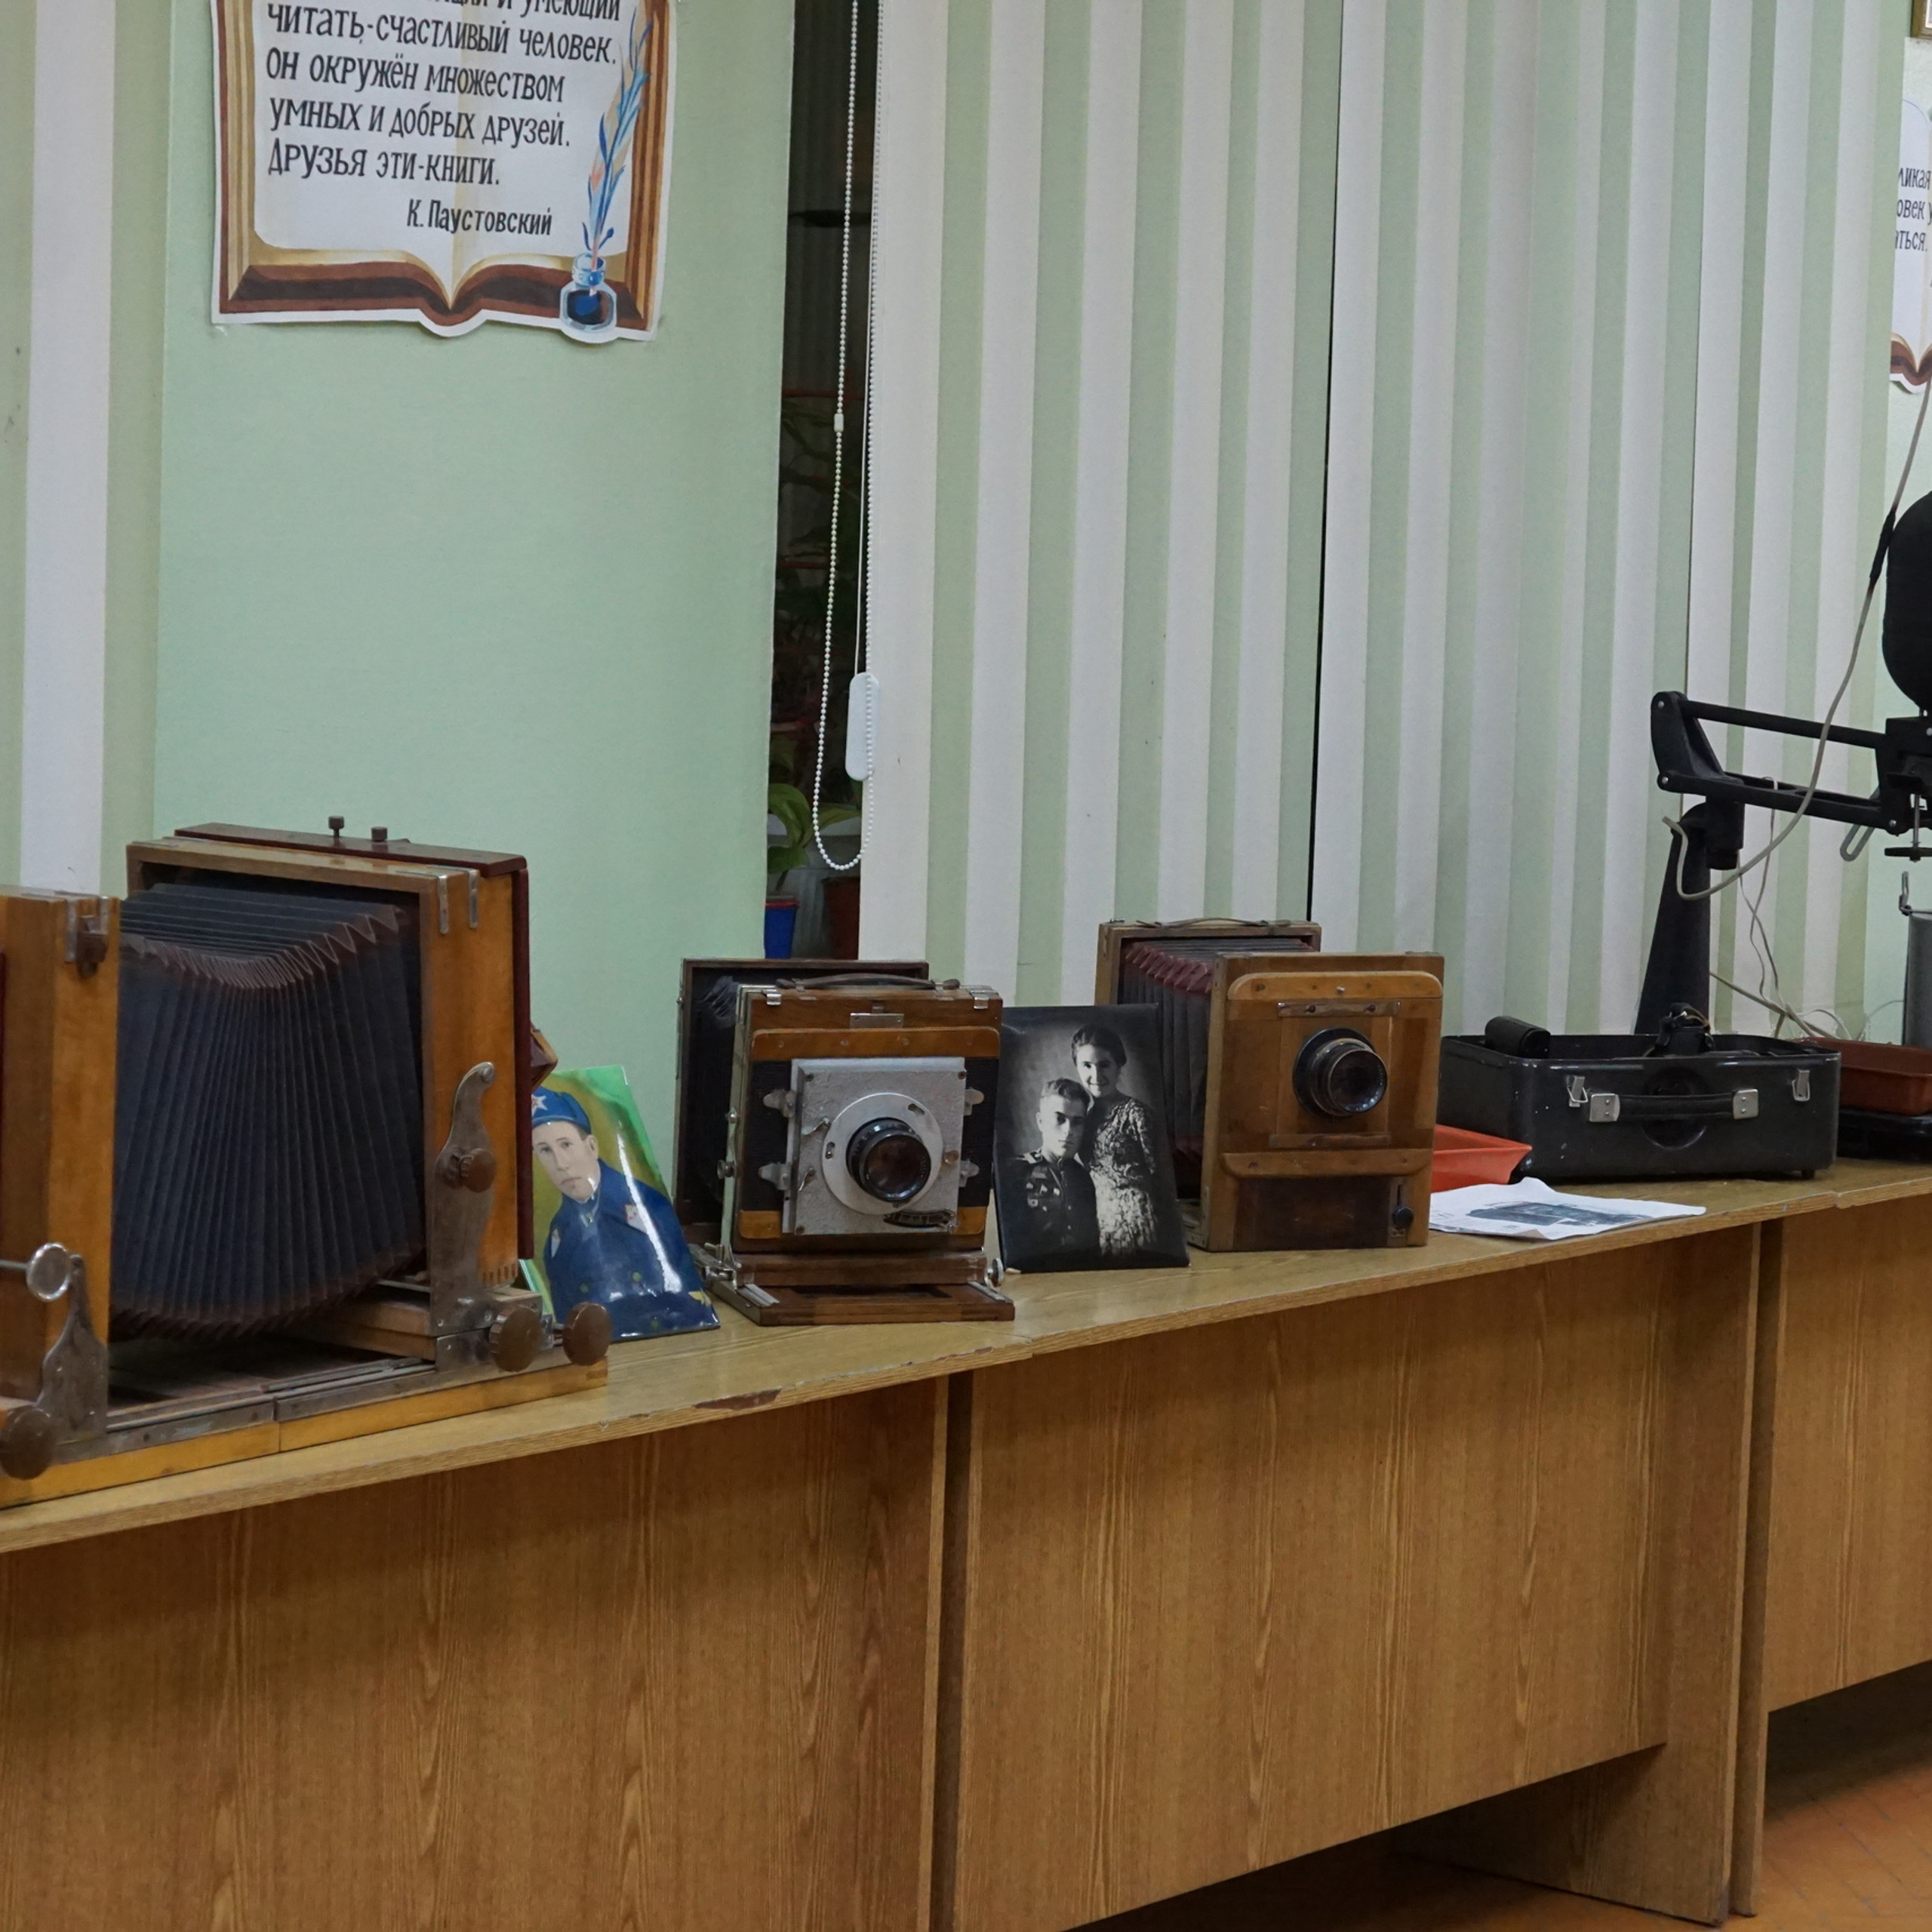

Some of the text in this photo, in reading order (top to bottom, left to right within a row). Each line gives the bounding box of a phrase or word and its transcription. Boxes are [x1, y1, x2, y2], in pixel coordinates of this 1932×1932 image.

[520, 29, 616, 64] человек.
[266, 47, 565, 103] Он окружён множеством
[270, 97, 569, 147] умных и добрых друзей.
[267, 137, 368, 179] Друзья
